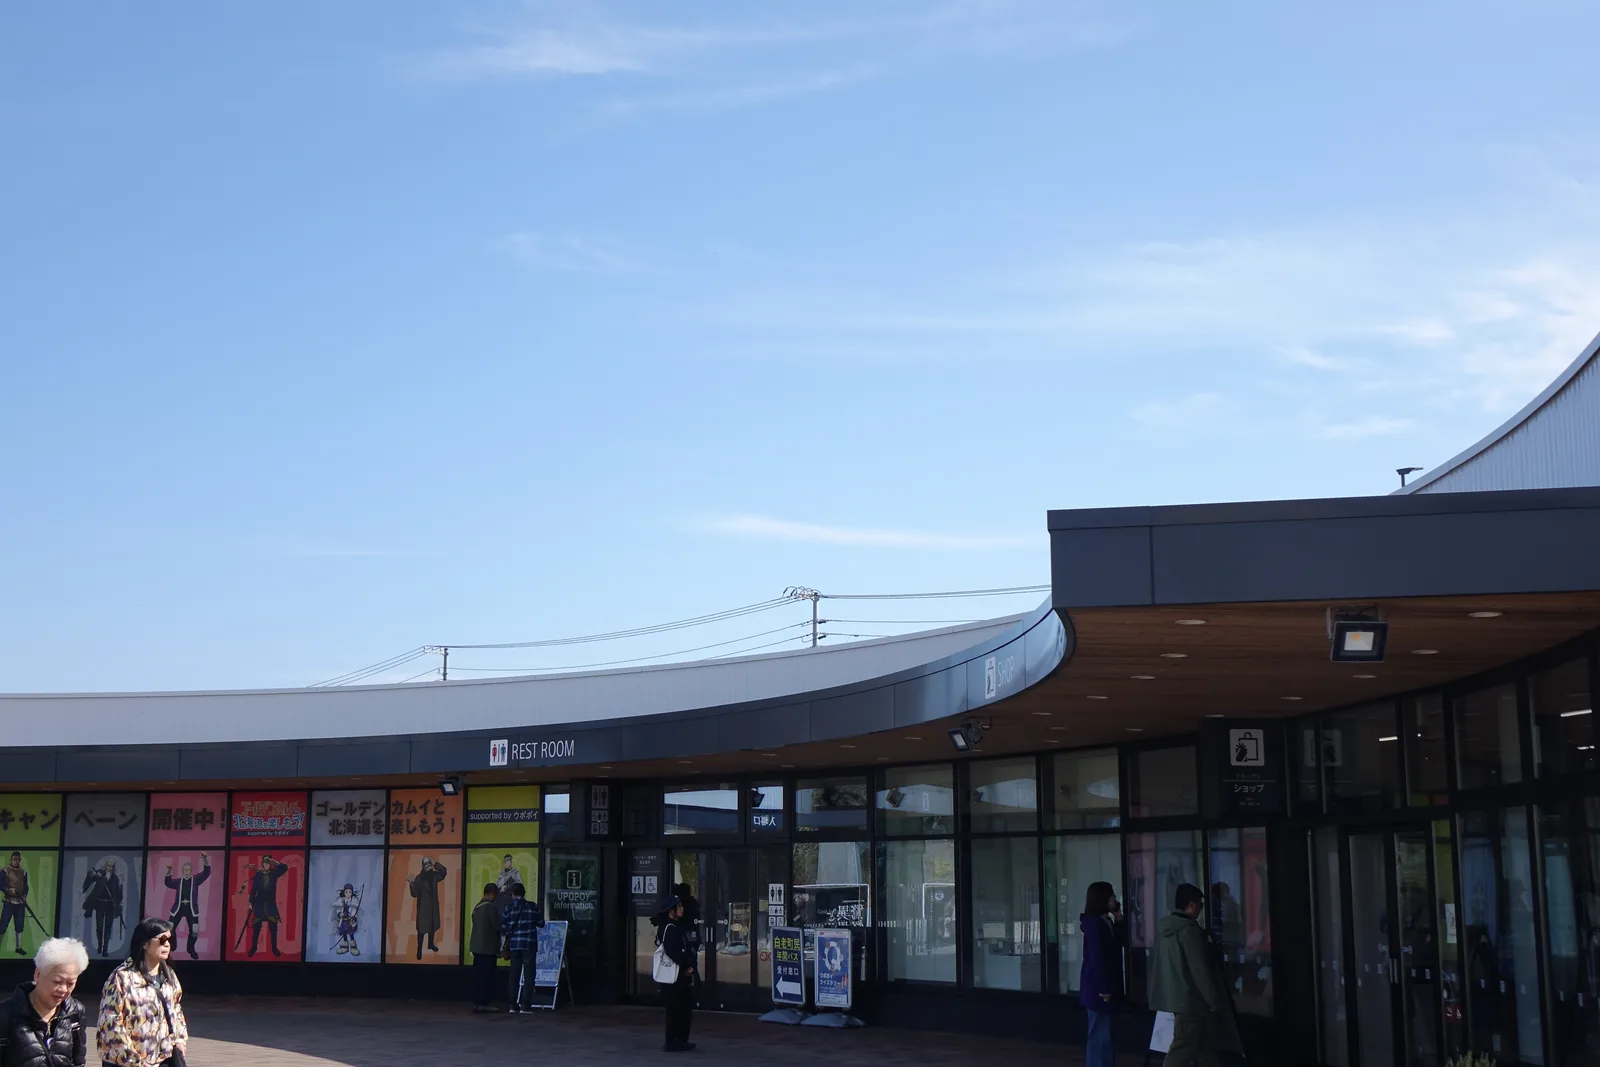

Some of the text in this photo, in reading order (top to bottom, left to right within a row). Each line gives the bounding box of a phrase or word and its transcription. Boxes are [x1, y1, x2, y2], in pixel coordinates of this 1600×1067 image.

[997, 656, 1015, 687] SHOP
[511, 739, 575, 760] REST ROOM
[1233, 783, 1264, 793] ショップ
[469, 811, 502, 821] supported
[503, 811, 512, 820] by
[557, 891, 590, 901] UPOPOY
[774, 936, 800, 950] 白老町民
[777, 965, 799, 976] 受付窓口
